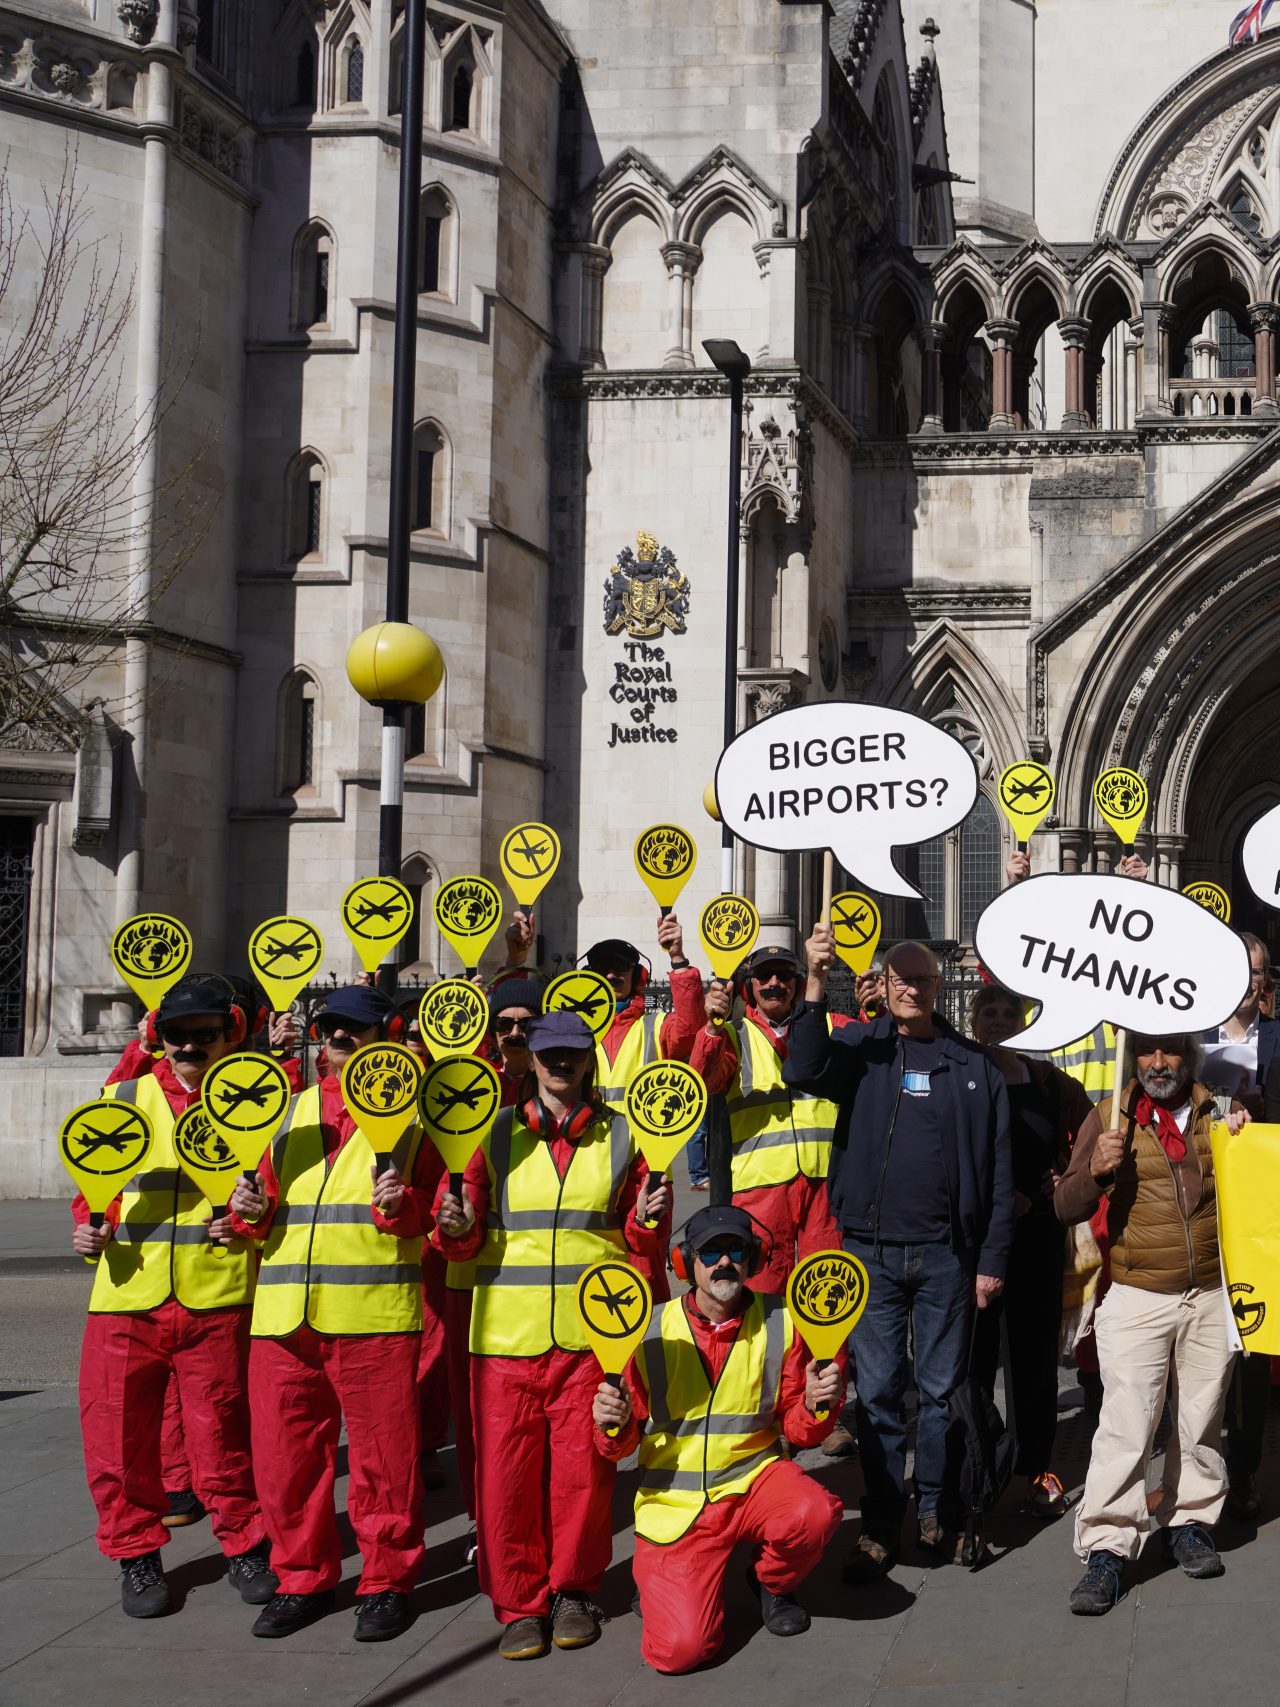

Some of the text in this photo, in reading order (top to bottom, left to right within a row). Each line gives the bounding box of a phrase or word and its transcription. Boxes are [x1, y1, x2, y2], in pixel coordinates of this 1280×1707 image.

[623, 642, 665, 662] The
[613, 661, 673, 685] Royal
[608, 682, 678, 704] Courts
[630, 702, 656, 723] of
[607, 723, 678, 748] Justice
[769, 732, 906, 771] BIGGER
[744, 777, 949, 822] AIRPORTS?
[1089, 898, 1154, 942] NO
[1020, 934, 1197, 1011] THANKS
